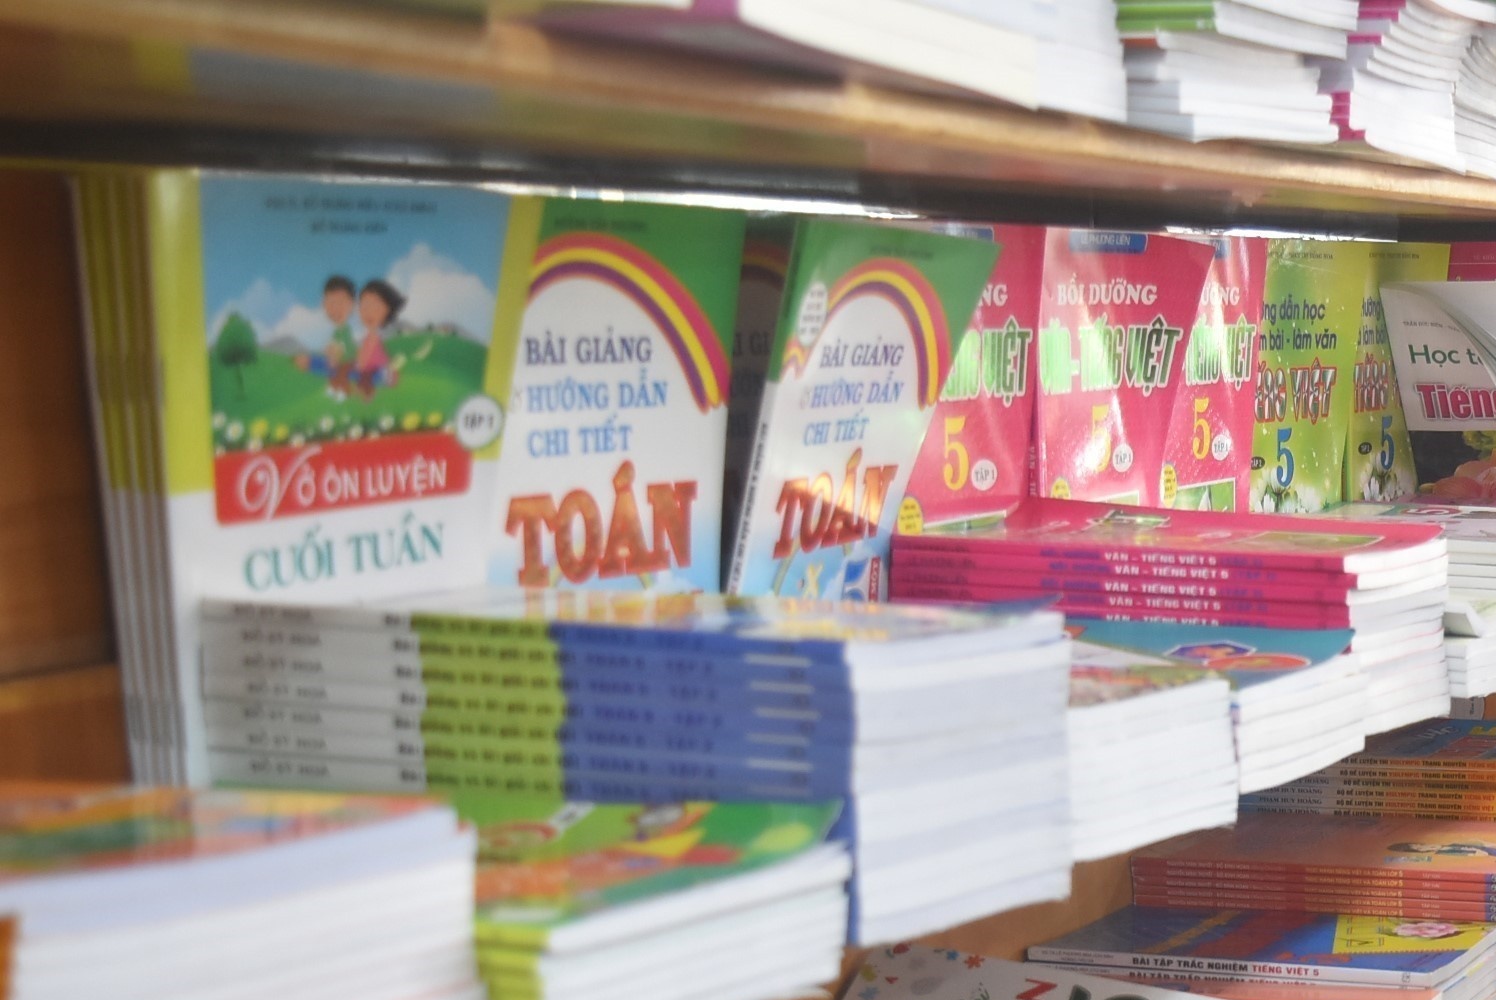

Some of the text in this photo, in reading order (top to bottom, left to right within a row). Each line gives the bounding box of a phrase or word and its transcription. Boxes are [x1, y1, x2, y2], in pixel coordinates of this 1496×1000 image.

[1057, 274, 1157, 306] BỒI DƯỠNG
[1279, 294, 1299, 320] dẫn
[1303, 299, 1326, 325] học
[525, 325, 653, 366] BÀI GIẢNG
[820, 337, 845, 369] BÀI
[851, 336, 904, 367] GIẢNG
[982, 314, 1032, 408] VIỆT
[1124, 313, 1183, 397] VIỆT
[1269, 326, 1337, 351] bài làm văn
[1408, 344, 1460, 369] Học
[1289, 357, 1338, 426] VIỆT
[527, 414, 633, 459] CHI TIẾT
[803, 410, 869, 448] CHI TIẾT
[1091, 405, 1111, 472] 5
[1193, 397, 1210, 460] 5
[1381, 415, 1395, 471] 5
[943, 415, 969, 491] 5
[975, 467, 991, 485] TẬP
[1276, 428, 1294, 488] 5
[322, 463, 360, 502] ÔN
[367, 453, 448, 499] LUYỆN
[505, 459, 699, 588] TOÁN
[773, 446, 899, 560] TOÁN
[242, 523, 336, 592] CUỐI
[1105, 552, 1205, 567] VĂN TIẾNG VIỆT
[1115, 565, 1217, 581] VĂN TIẾNG VIỆT
[1132, 957, 1320, 978] BÀI TẬP TRẮC NGHIỆM TIẾNG VIỆT 5
